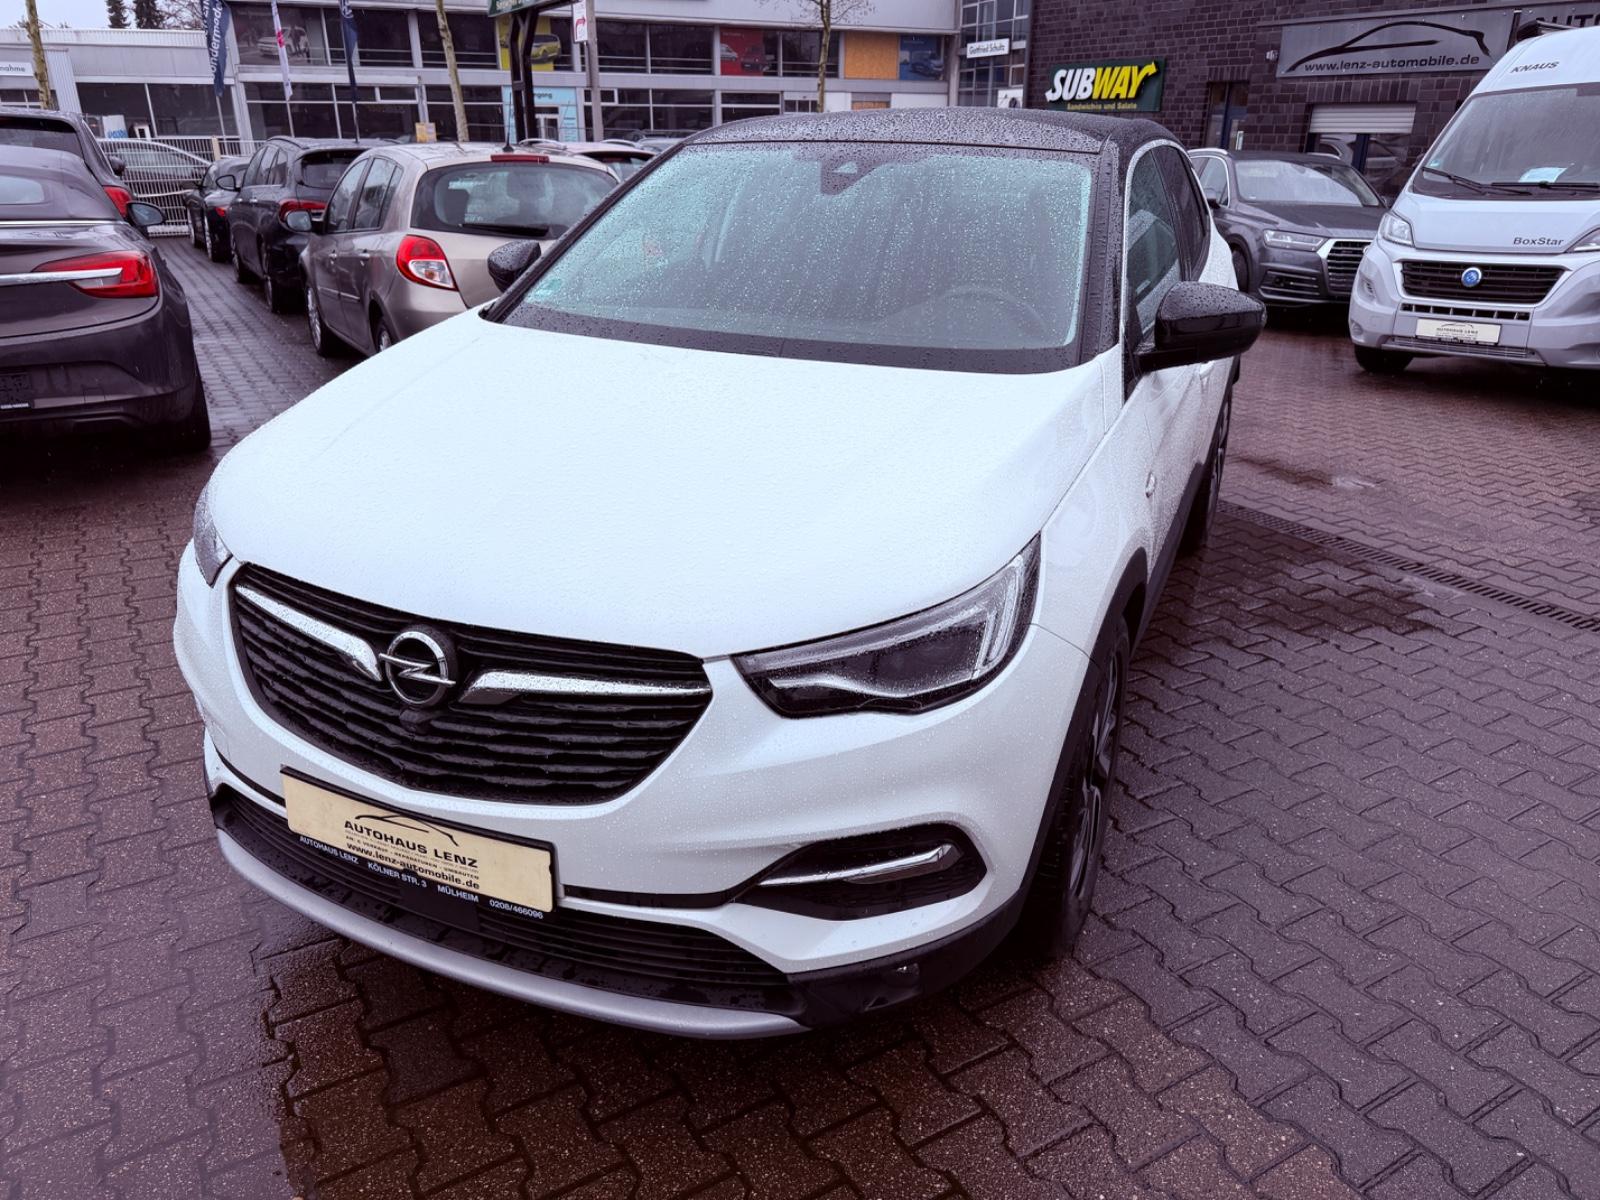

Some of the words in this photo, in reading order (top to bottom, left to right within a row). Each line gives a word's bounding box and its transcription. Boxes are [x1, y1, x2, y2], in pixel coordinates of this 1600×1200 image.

[1044, 61, 1157, 102] SUBWAY
[1304, 54, 1480, 72] www.lenz-automobile.de
[1510, 61, 1560, 74] KNAUS
[1513, 236, 1565, 246] BoxStar
[344, 820, 428, 855] AUTOHAUS
[434, 848, 478, 869] LENZ
[299, 835, 339, 857] AUTOHAUS
[339, 850, 360, 865] LENZ
[367, 861, 400, 879] KÖLNER
[401, 873, 420, 886] STR.
[420, 880, 428, 888] 3
[437, 884, 480, 903] MÜLHEIM
[346, 842, 481, 890] www.lenz-automobile.de
